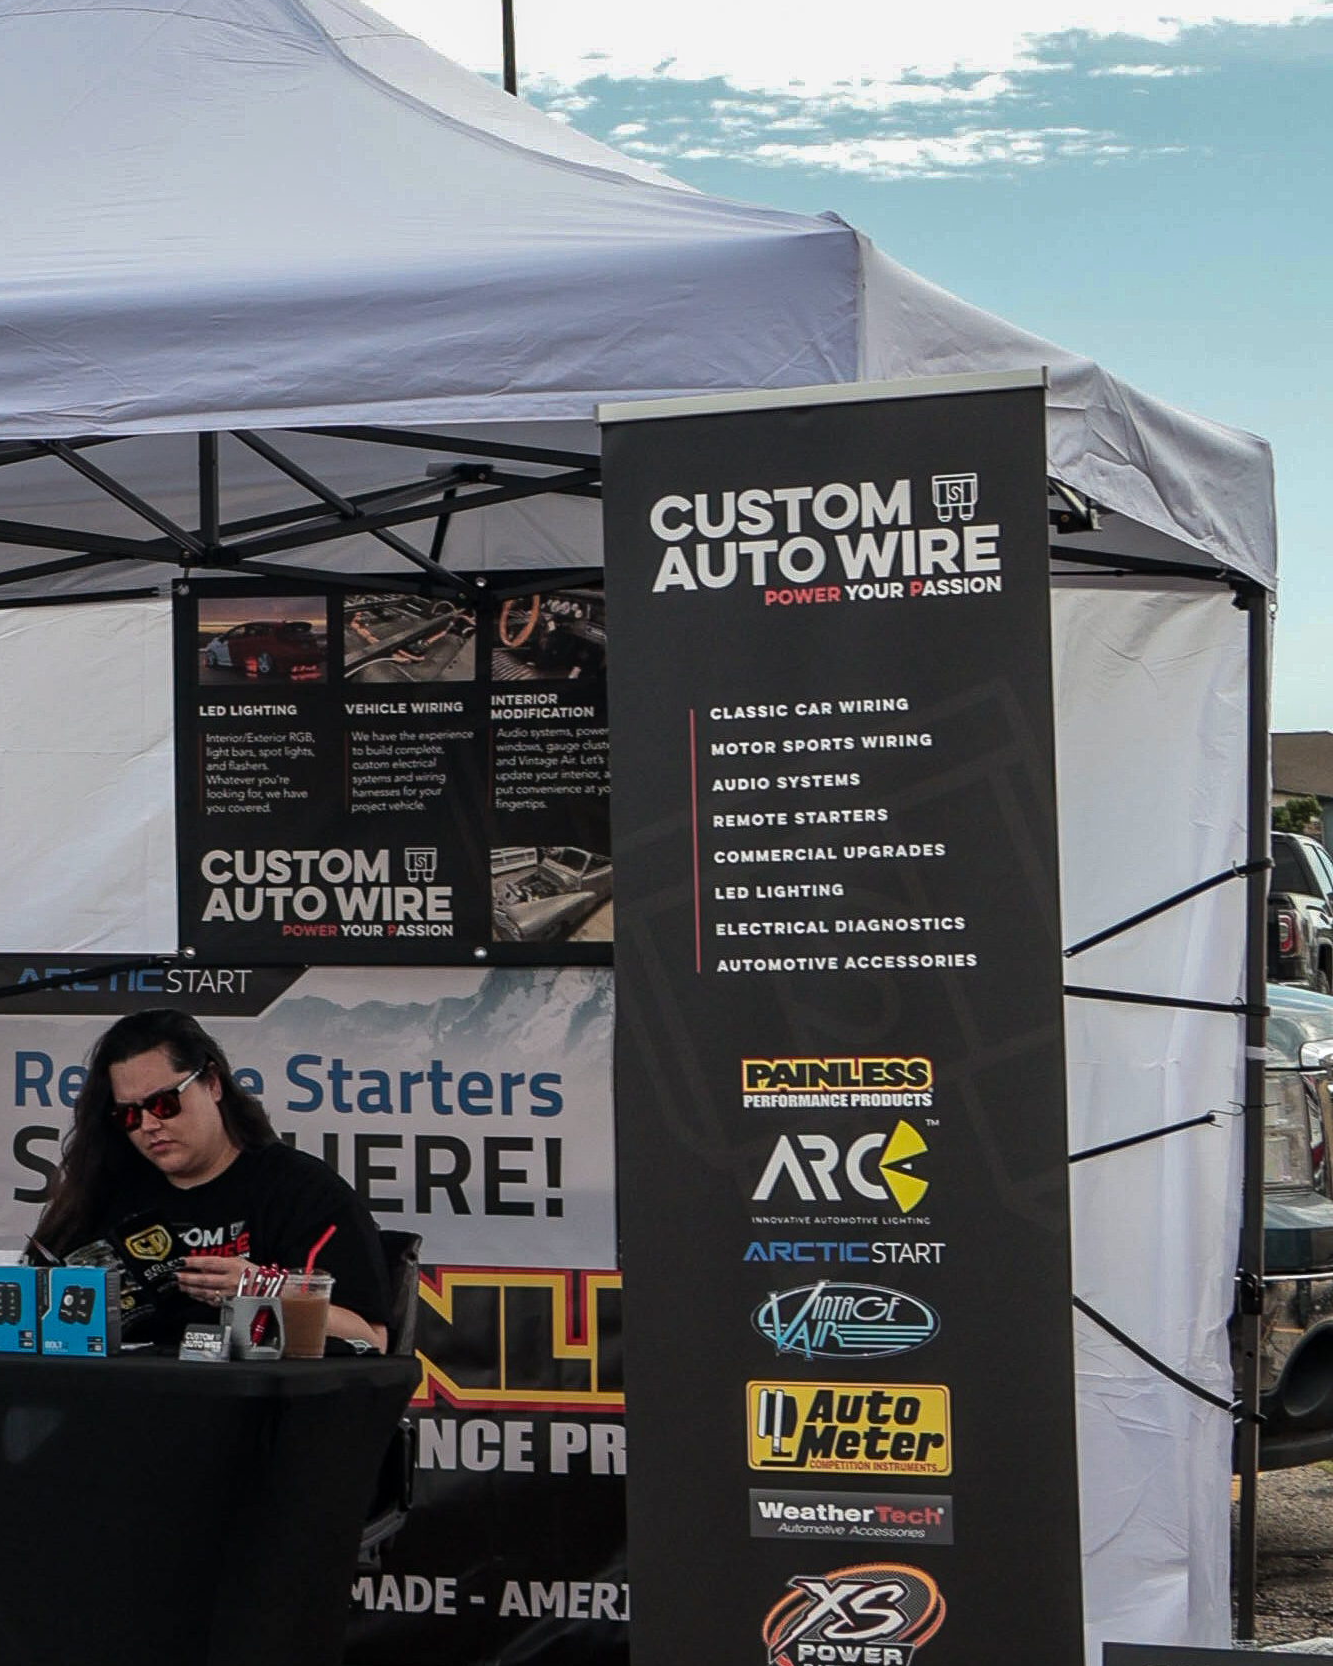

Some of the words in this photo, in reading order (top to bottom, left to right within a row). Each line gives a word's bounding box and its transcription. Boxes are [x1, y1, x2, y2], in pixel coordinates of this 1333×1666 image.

[650, 480, 914, 544] CUSTOM
[652, 536, 829, 595] AUTO
[835, 524, 1001, 583] WIRE
[765, 586, 841, 605] POWER
[845, 583, 904, 600] YOUR
[910, 576, 1001, 596] PASSION
[345, 703, 407, 714] VEHICLE
[411, 702, 463, 713] WIRING
[491, 694, 557, 705] INTERIOR
[710, 705, 787, 720] CLASSIC
[795, 702, 832, 715] CAR
[839, 698, 908, 713] WIRING
[200, 706, 226, 716] LED
[230, 705, 297, 716] LIGHTING
[491, 706, 594, 719] MODIFICATION
[712, 742, 775, 755] MOTOR
[783, 737, 854, 752] SPORTS
[861, 734, 932, 748] WIRING
[712, 778, 770, 791] AUDIO
[777, 773, 860, 789] SYSTEMS
[713, 813, 787, 827] REMOTE
[795, 809, 888, 824] STARTERS
[714, 848, 837, 863] COMMERCIAL
[844, 844, 945, 858] UPGRADES
[201, 849, 389, 884] CUSTOM
[715, 887, 749, 899] LED
[756, 884, 843, 898] LIGHTING
[202, 886, 327, 921] AUTO
[334, 887, 453, 921] WIRE
[283, 924, 337, 936] POWER
[341, 925, 383, 936] YOUR
[388, 925, 453, 936] PASSION
[716, 921, 829, 935] ELECTRICAL
[835, 917, 965, 932] DIAGNOSTICS
[717, 957, 838, 972] AUTOMOTIVE
[845, 954, 977, 969] ACCESSORIES
[742, 1056, 933, 1092] PAINLESS
[286, 1053, 563, 1117] Starters
[743, 1094, 848, 1108] PERFORMANCE
[851, 1093, 932, 1106] PRODUCTS
[751, 1133, 889, 1201] ARC
[882, 1217, 931, 1225] LIGHTING
[806, 1390, 920, 1425] Auto
[801, 1425, 944, 1461] Meter
[810, 1459, 871, 1471] COMPETITION
[873, 1461, 938, 1472] INSTRUMENTS
[758, 1501, 941, 1526] WeatherTech
[777, 1522, 845, 1536] Automotive
[849, 1525, 926, 1538] Accessories
[773, 1576, 909, 1653] XS
[797, 1644, 904, 1665] POWER
